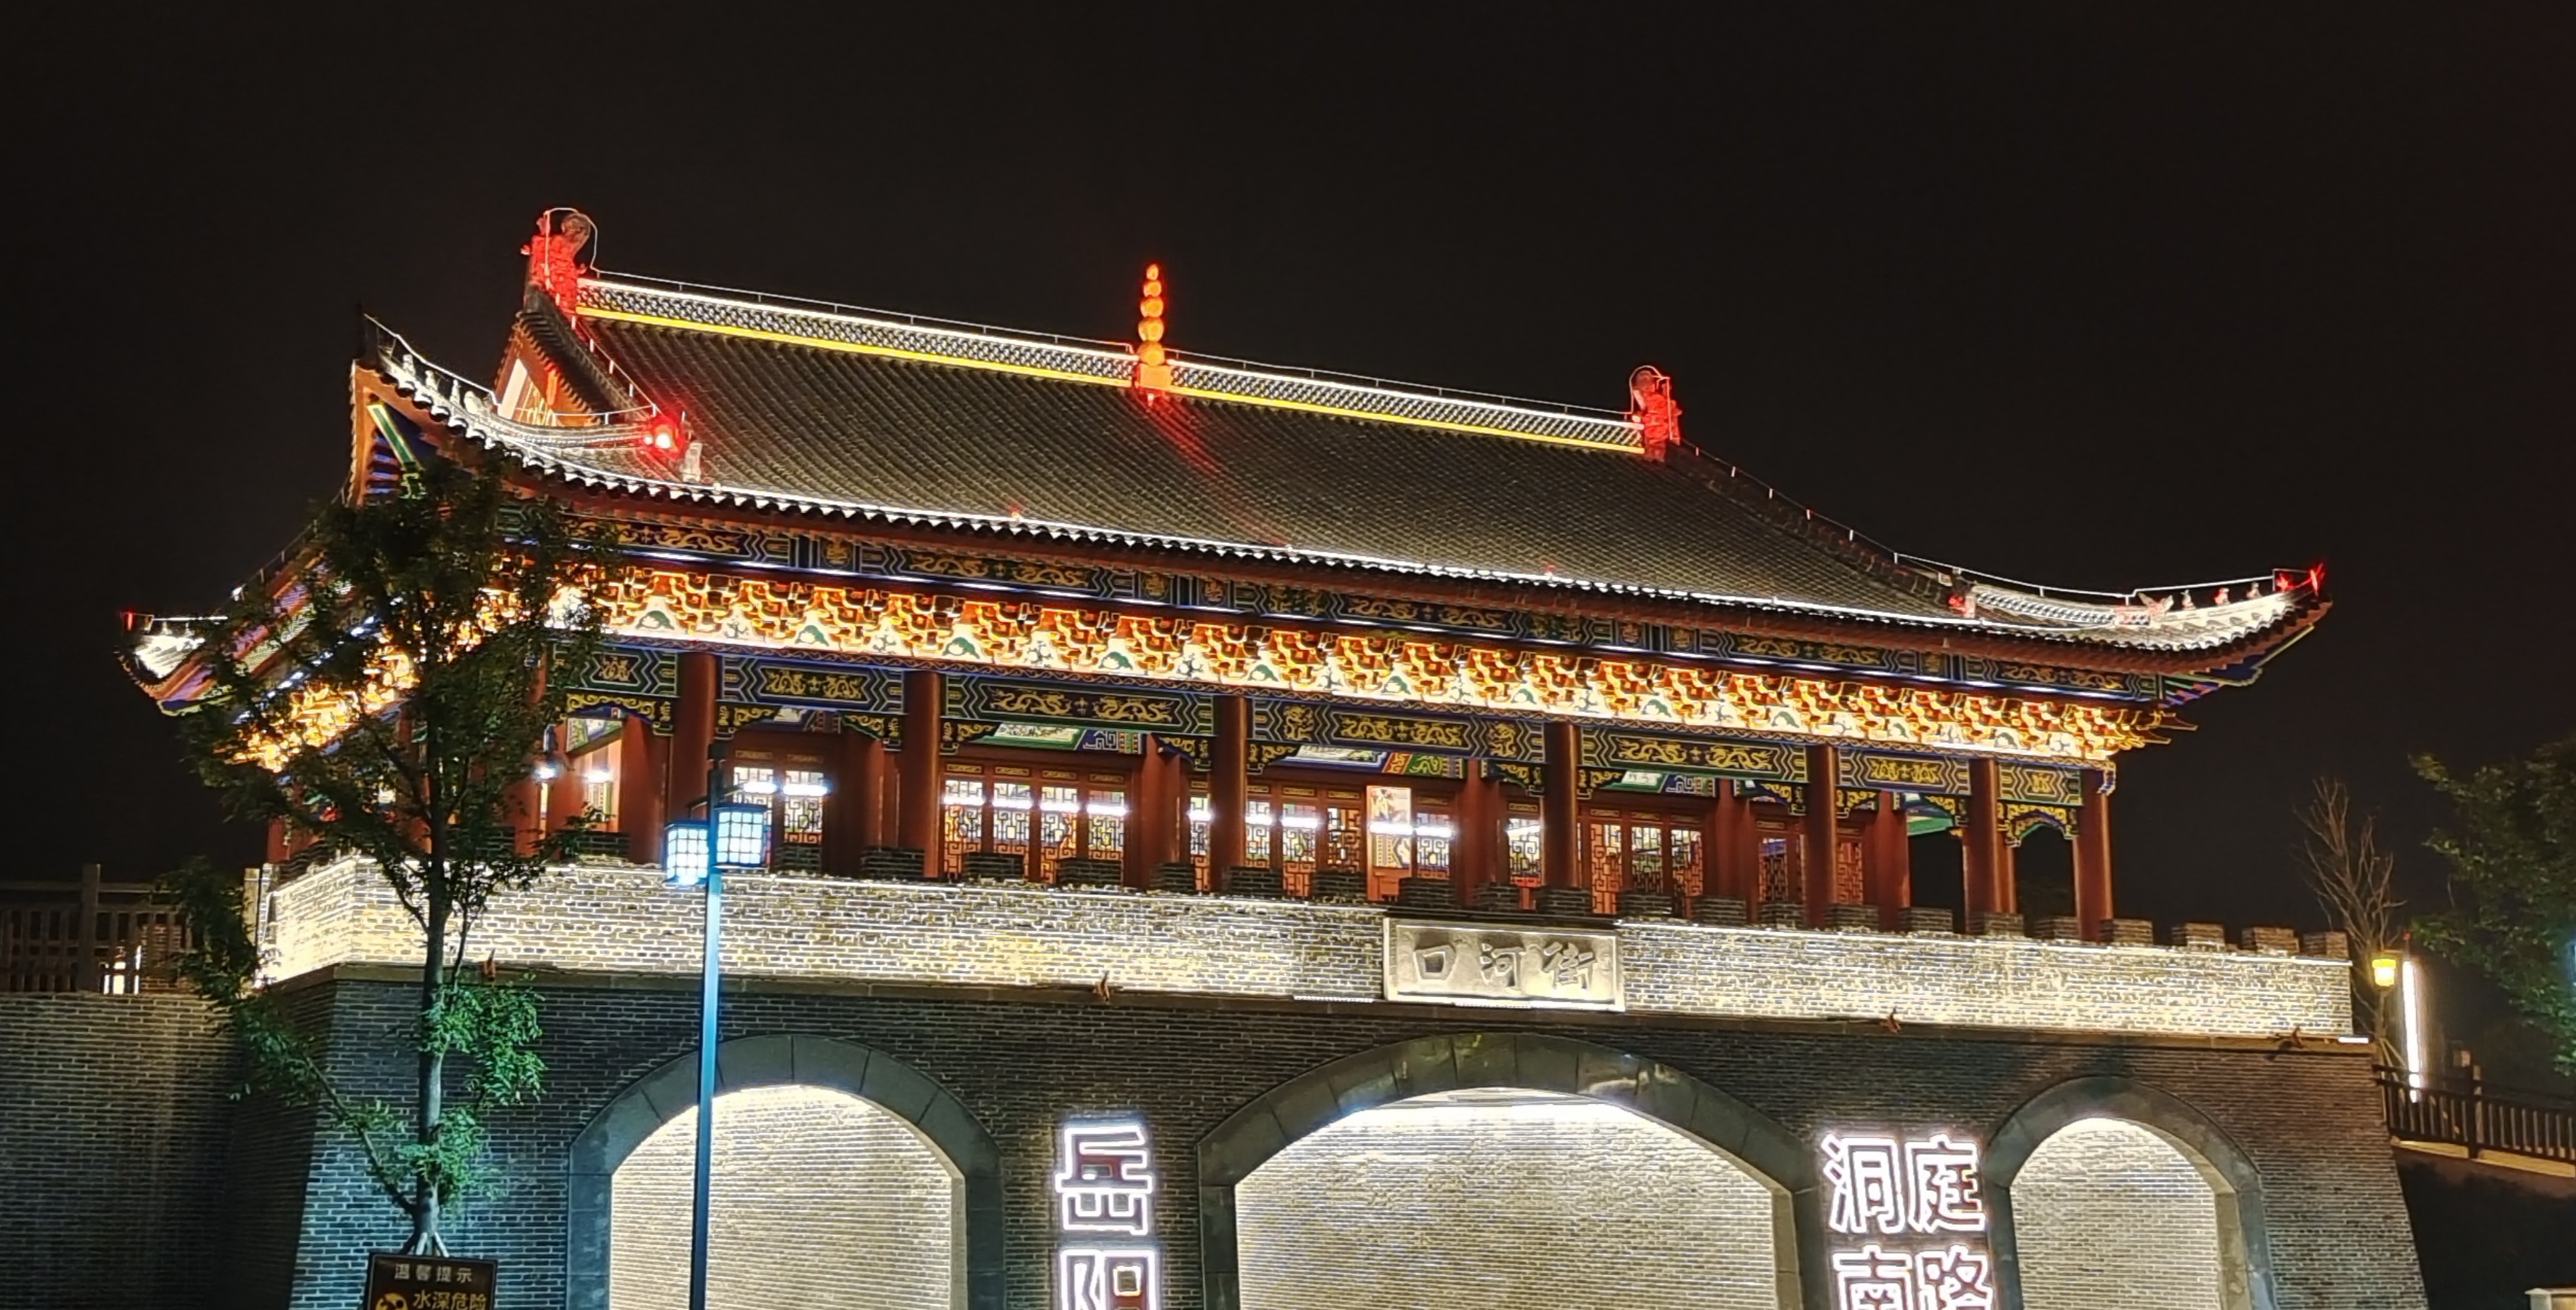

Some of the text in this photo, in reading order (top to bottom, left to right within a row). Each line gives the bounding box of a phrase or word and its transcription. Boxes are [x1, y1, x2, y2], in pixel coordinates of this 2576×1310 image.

[1821, 1133, 1986, 1233] 洞庭
[394, 1263, 472, 1283] 温馨提示
[413, 1290, 487, 1310] 水深危险
